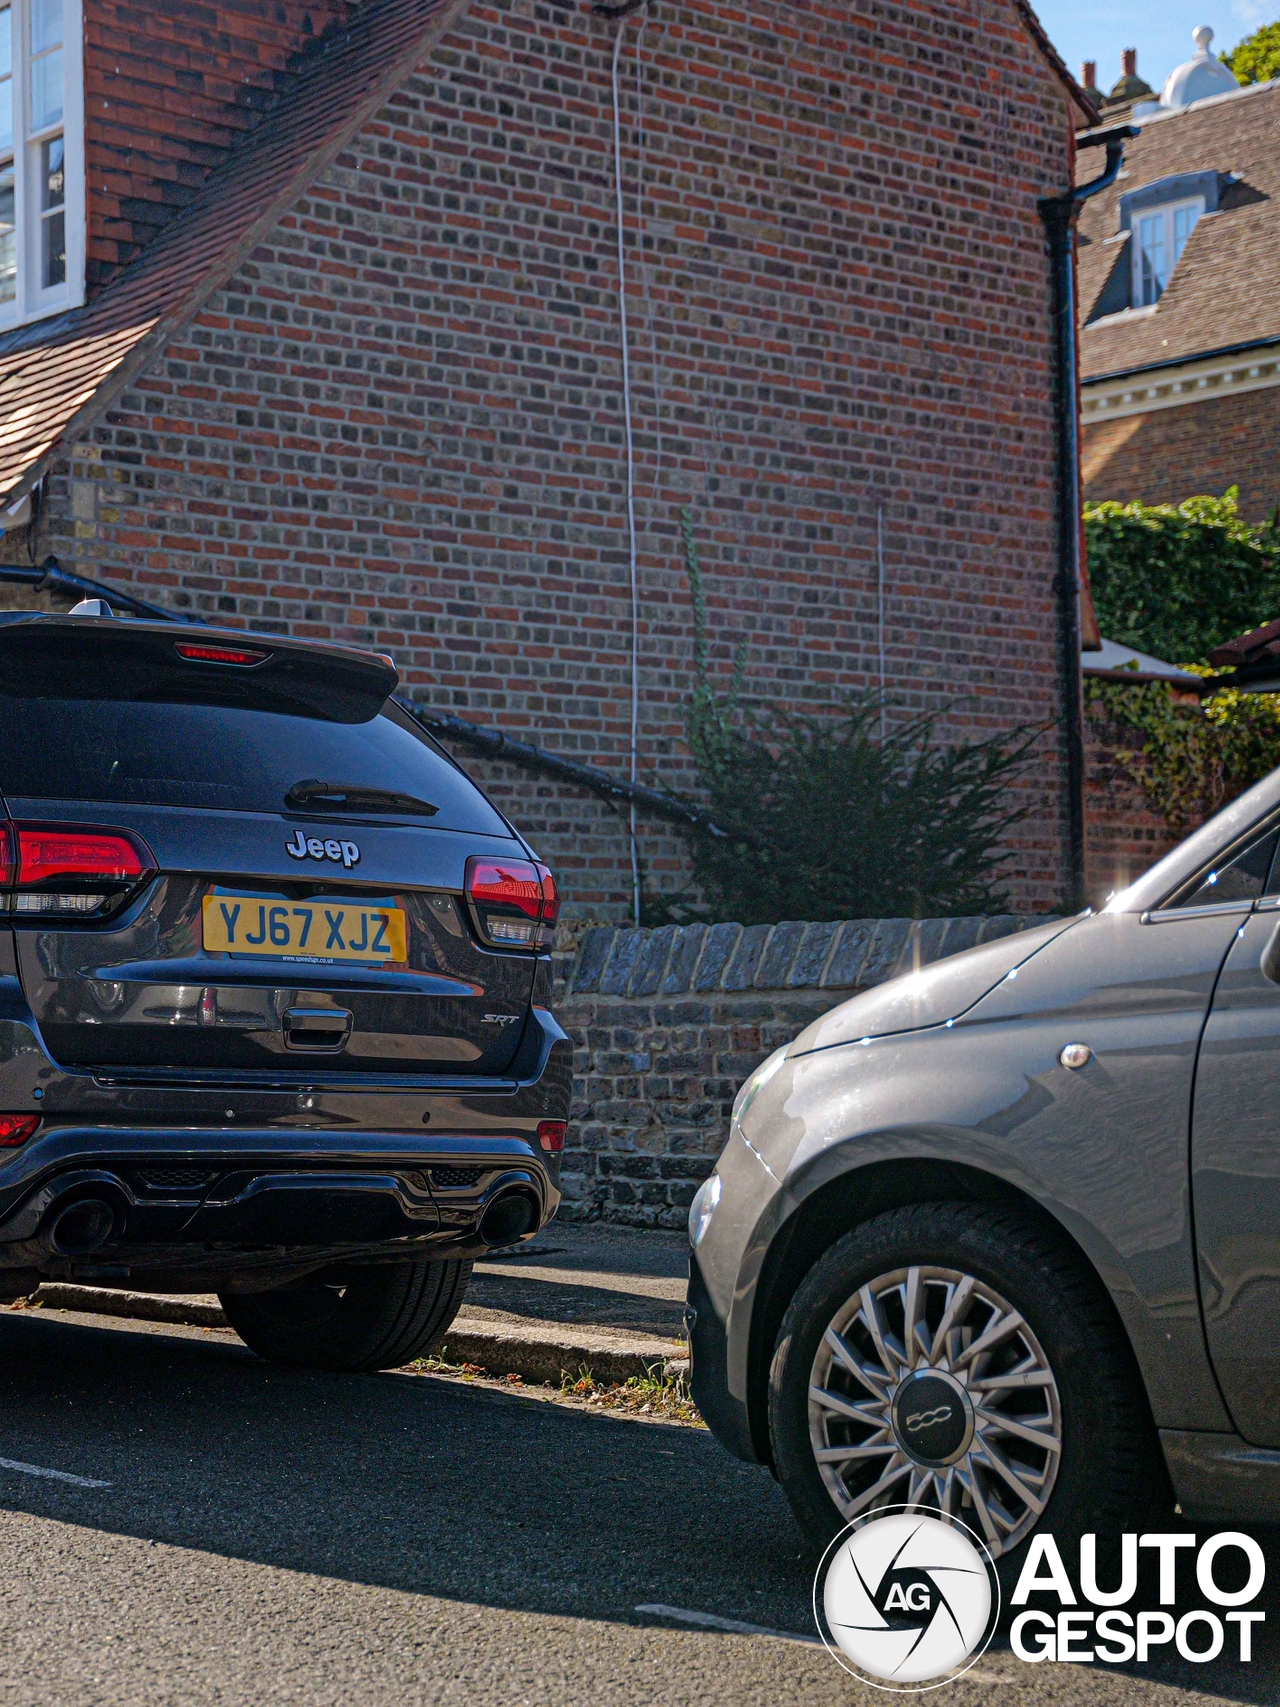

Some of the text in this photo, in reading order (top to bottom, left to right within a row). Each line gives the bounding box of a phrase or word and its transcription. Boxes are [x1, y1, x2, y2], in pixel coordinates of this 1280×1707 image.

[285, 830, 360, 869] Jeep
[220, 903, 391, 953] YJ67 XJZ
[480, 1013, 520, 1027] SRT
